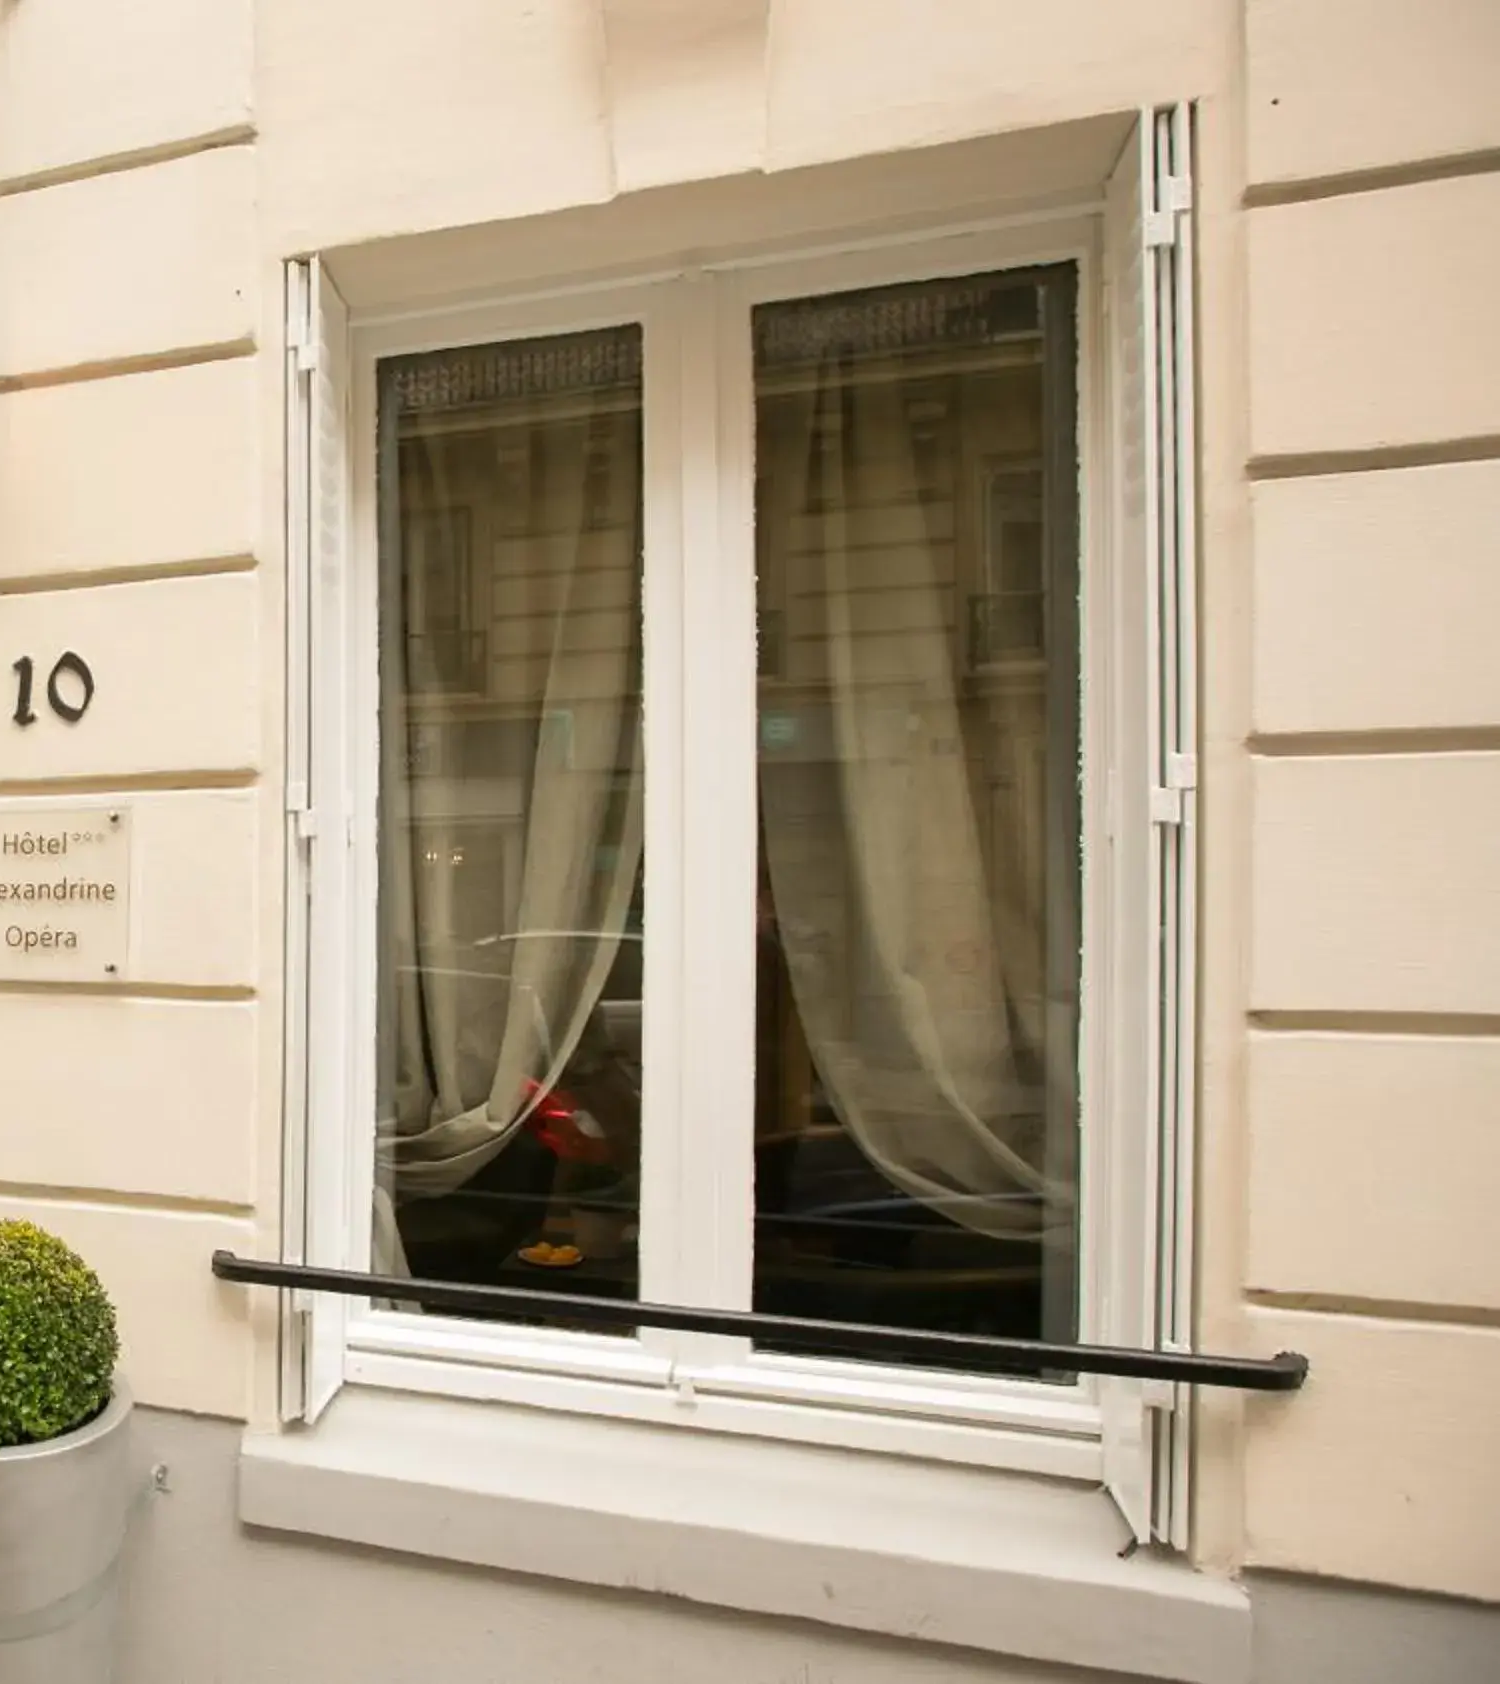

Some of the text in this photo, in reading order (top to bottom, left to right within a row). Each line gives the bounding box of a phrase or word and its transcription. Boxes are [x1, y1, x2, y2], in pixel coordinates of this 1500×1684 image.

[12, 651, 95, 726] 10
[2, 831, 67, 855] Hôtel
[5, 923, 78, 952] Opéra
